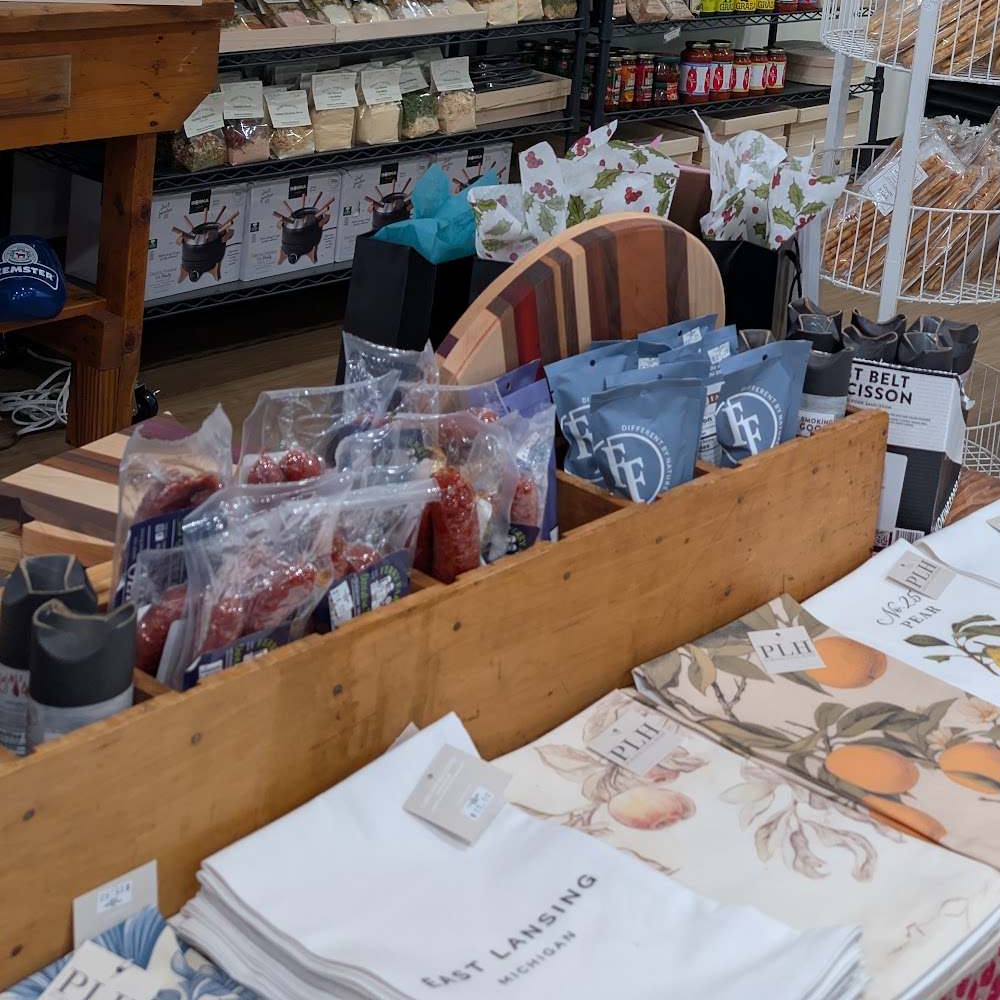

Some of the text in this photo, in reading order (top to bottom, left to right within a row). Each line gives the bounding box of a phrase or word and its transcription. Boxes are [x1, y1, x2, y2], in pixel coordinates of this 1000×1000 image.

[869, 370, 911, 388] BELT
[740, 385, 777, 403] DIFFERENT
[774, 404, 782, 413] BY
[801, 416, 834, 425] SMOKING
[621, 424, 663, 445] DIFFERENT
[661, 445, 670, 456] BY
[906, 559, 938, 589] PLH
[900, 604, 942, 630] PEAR
[759, 640, 815, 660] PLH
[609, 721, 661, 762] PLH
[421, 871, 600, 990] EAST LANSING
[497, 929, 578, 988] MICHIGAN
